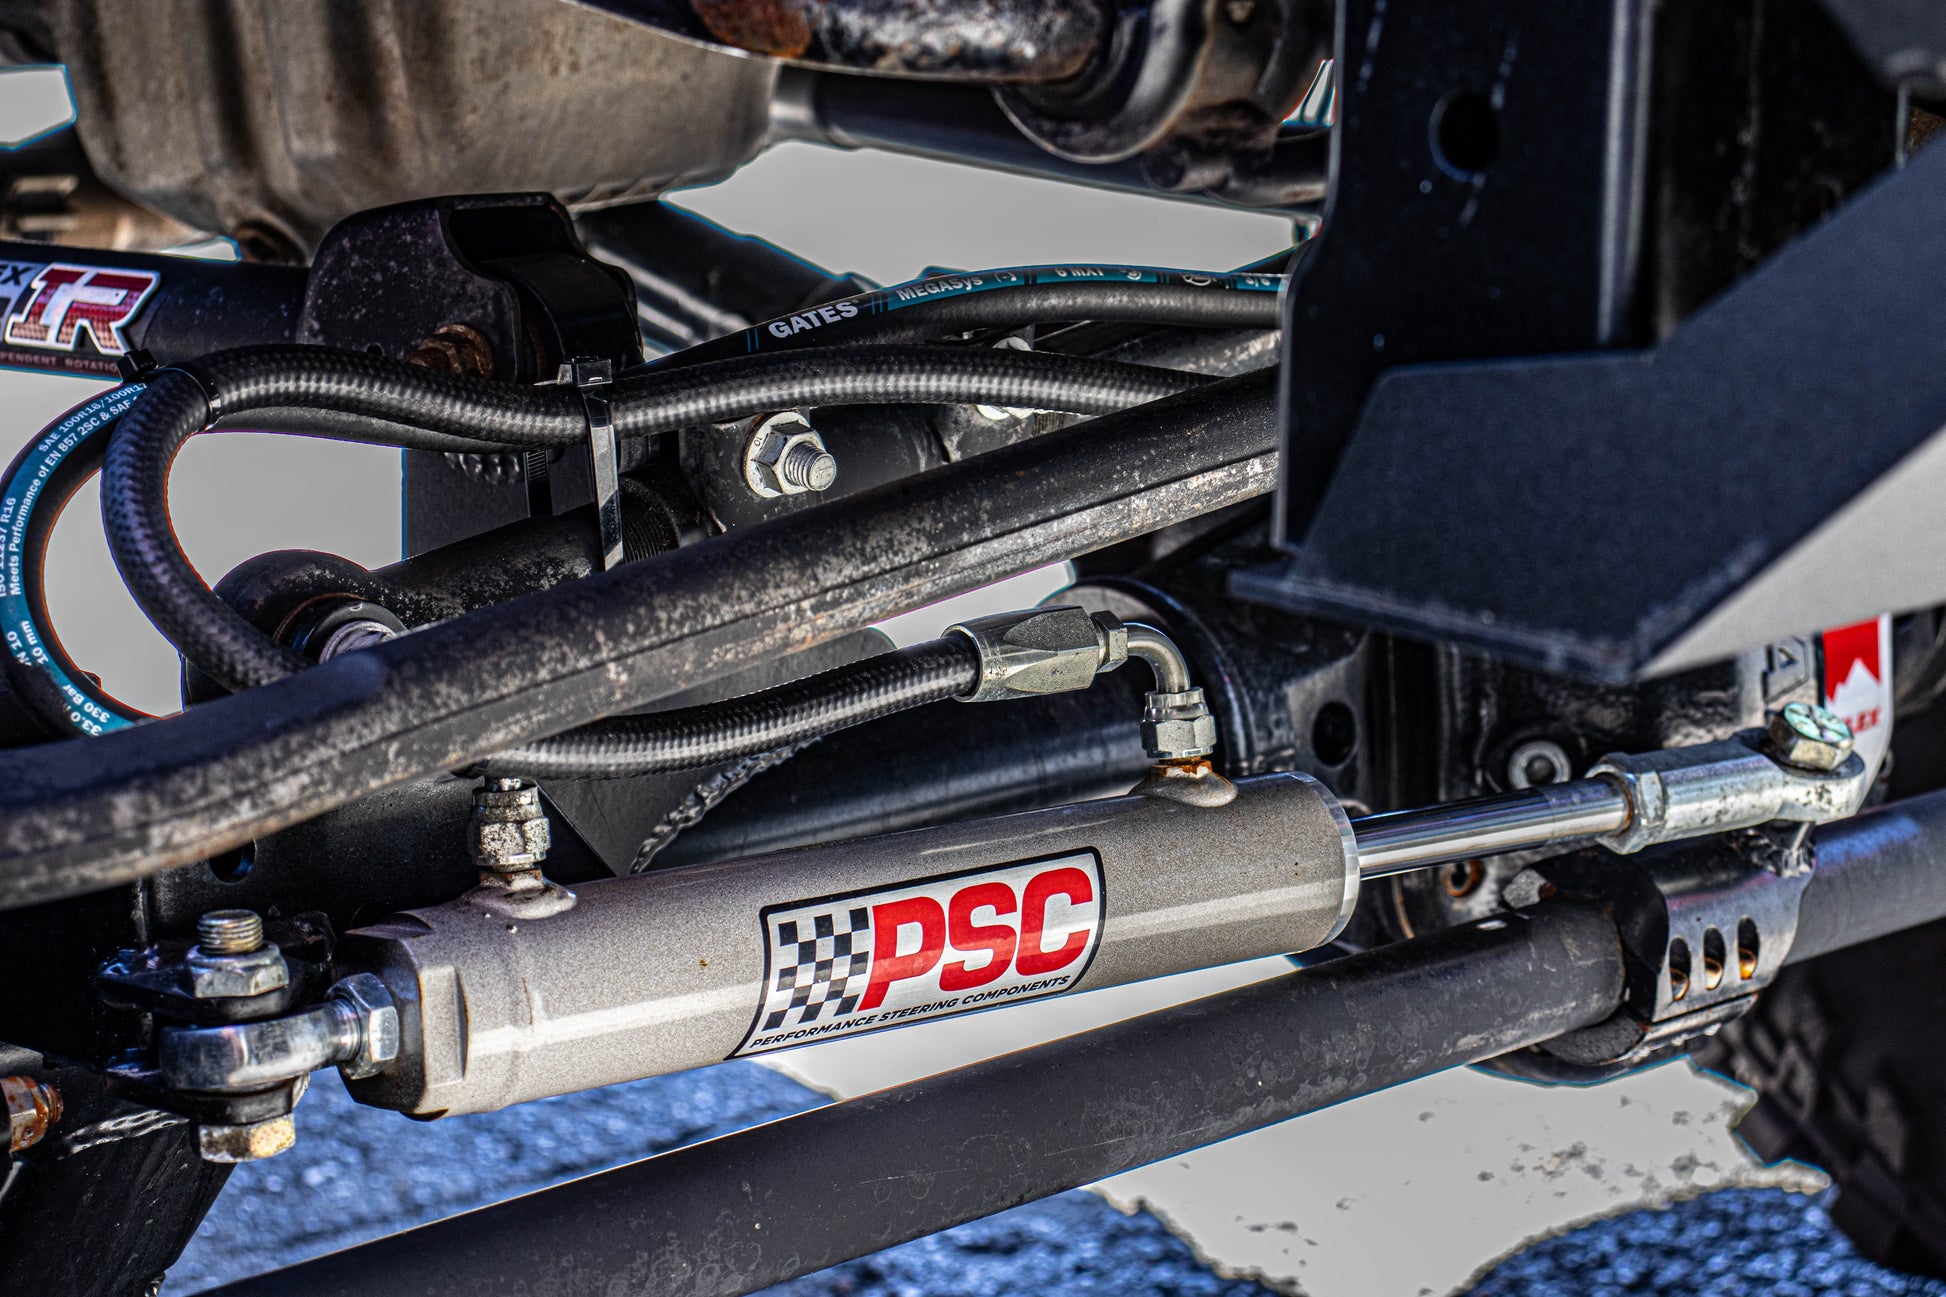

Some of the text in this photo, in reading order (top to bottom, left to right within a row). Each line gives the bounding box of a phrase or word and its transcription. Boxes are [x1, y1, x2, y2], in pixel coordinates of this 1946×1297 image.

[768, 275, 983, 338] GATES MEGASys
[64, 357, 118, 373] ROTATIO
[39, 432, 61, 452] SAE
[58, 433, 78, 452] 857
[77, 418, 100, 436] 2SC
[38, 465, 49, 478] of
[45, 451, 62, 467] EN
[0, 497, 16, 523] R16
[9, 479, 41, 552] Performance
[8, 555, 21, 595] Meets
[7, 630, 32, 666] N 10
[20, 620, 49, 664] 10 mm
[62, 684, 110, 723] 330 Bar
[858, 867, 1093, 1012] PSC
[750, 975, 1071, 1048] PERFORMANCE STEERING COMPONENTS
